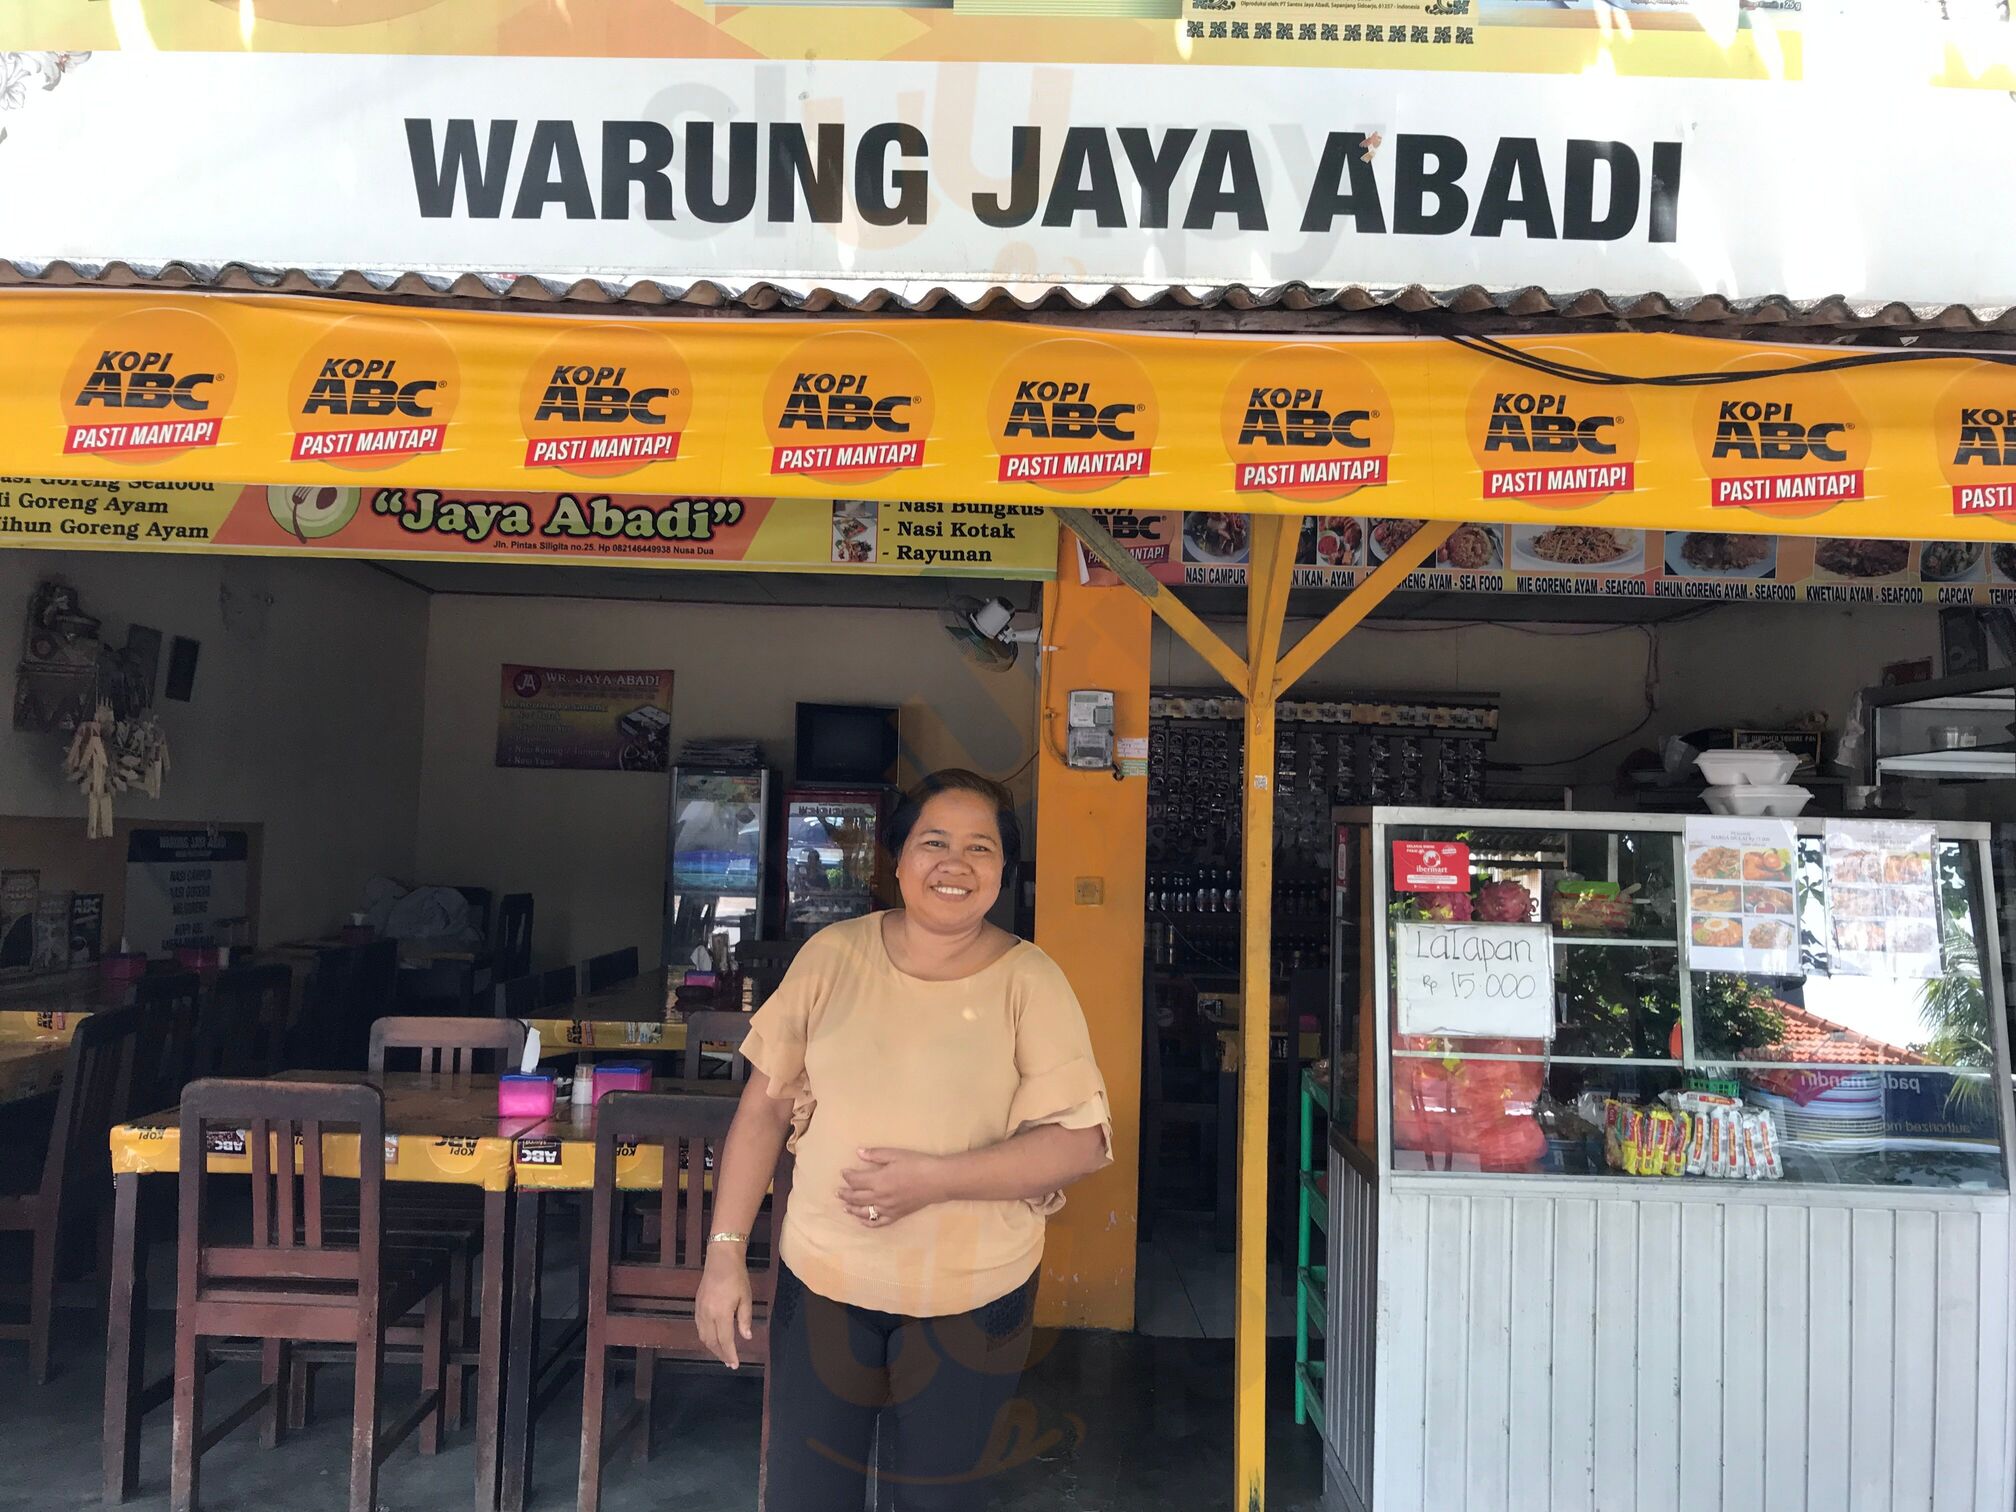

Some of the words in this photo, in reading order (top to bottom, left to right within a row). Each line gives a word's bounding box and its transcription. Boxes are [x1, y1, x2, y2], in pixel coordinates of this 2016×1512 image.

[404, 117, 930, 227] WARUNG
[971, 124, 1269, 232] JAYA
[1300, 131, 1683, 244] ABADI
[96, 350, 173, 372] KOPI
[320, 358, 396, 379] KOPI
[550, 365, 627, 386] KOPI
[793, 372, 868, 395] KOPI
[1015, 380, 1091, 403] KOPI
[1248, 387, 1324, 409] KOPI
[1492, 393, 1568, 416] KOPI
[1719, 400, 1793, 422] KOPI
[73, 426, 128, 450] PASTI
[130, 421, 213, 446] MANTAP!
[299, 433, 355, 456] PASTI
[356, 428, 437, 453] MANTAP!
[533, 439, 588, 463] PASTI
[590, 435, 672, 459] MANTAP!
[780, 447, 833, 469] PASTI
[836, 443, 918, 467] MANTAP!
[1007, 457, 1060, 478] PASTI
[1062, 452, 1144, 474] MANTAP!
[1242, 464, 1296, 486] PASTI
[1298, 459, 1381, 483] MANTAP!
[1490, 471, 1543, 494] PASTI
[1546, 466, 1627, 491] MANTAP!
[1719, 479, 1771, 501] PASTI
[1775, 473, 1857, 499] MANTAP!
[18, 492, 98, 515] Goreng
[104, 496, 169, 516] Ayam
[1961, 487, 2013, 509] PASTI
[0, 516, 51, 534] ihun
[60, 518, 140, 540] Goreng
[145, 521, 209, 542] Ayam
[897, 521, 943, 538] Nasi
[950, 522, 1015, 539] Kotak
[511, 541, 537, 550] Pintas
[598, 544, 611, 553] Hp
[673, 545, 695, 554] Nusa
[697, 547, 714, 555] Dua
[896, 545, 993, 565] Rayunan
[1129, 546, 1165, 560] ANTAP!
[1186, 567, 1206, 584] NASI
[1209, 568, 1246, 585] CAMPUR
[1302, 570, 1323, 586] IKAN
[1331, 571, 1355, 587] AYAM
[1428, 574, 1452, 590] AYAM
[1460, 575, 1477, 591] SEA
[1479, 576, 1503, 591] FOOD
[1516, 576, 1534, 593] MIE
[1535, 577, 1572, 594] GORENG
[1575, 578, 1598, 594] AYAM
[1605, 580, 1646, 596] SEAFOOD
[1654, 581, 1683, 597] BIHUN
[1685, 582, 1722, 598] GORENG
[1724, 583, 1747, 600] AYAM
[1755, 584, 1796, 601] SEAFOOD
[1806, 585, 1847, 602] KWETIAU
[1849, 586, 1873, 603] AYAM
[1881, 587, 1923, 603] SEAFOOD
[1938, 588, 1975, 604] CAPCAY
[545, 671, 570, 684] WR.
[575, 674, 612, 685] JAYA
[615, 675, 660, 686] ABADI
